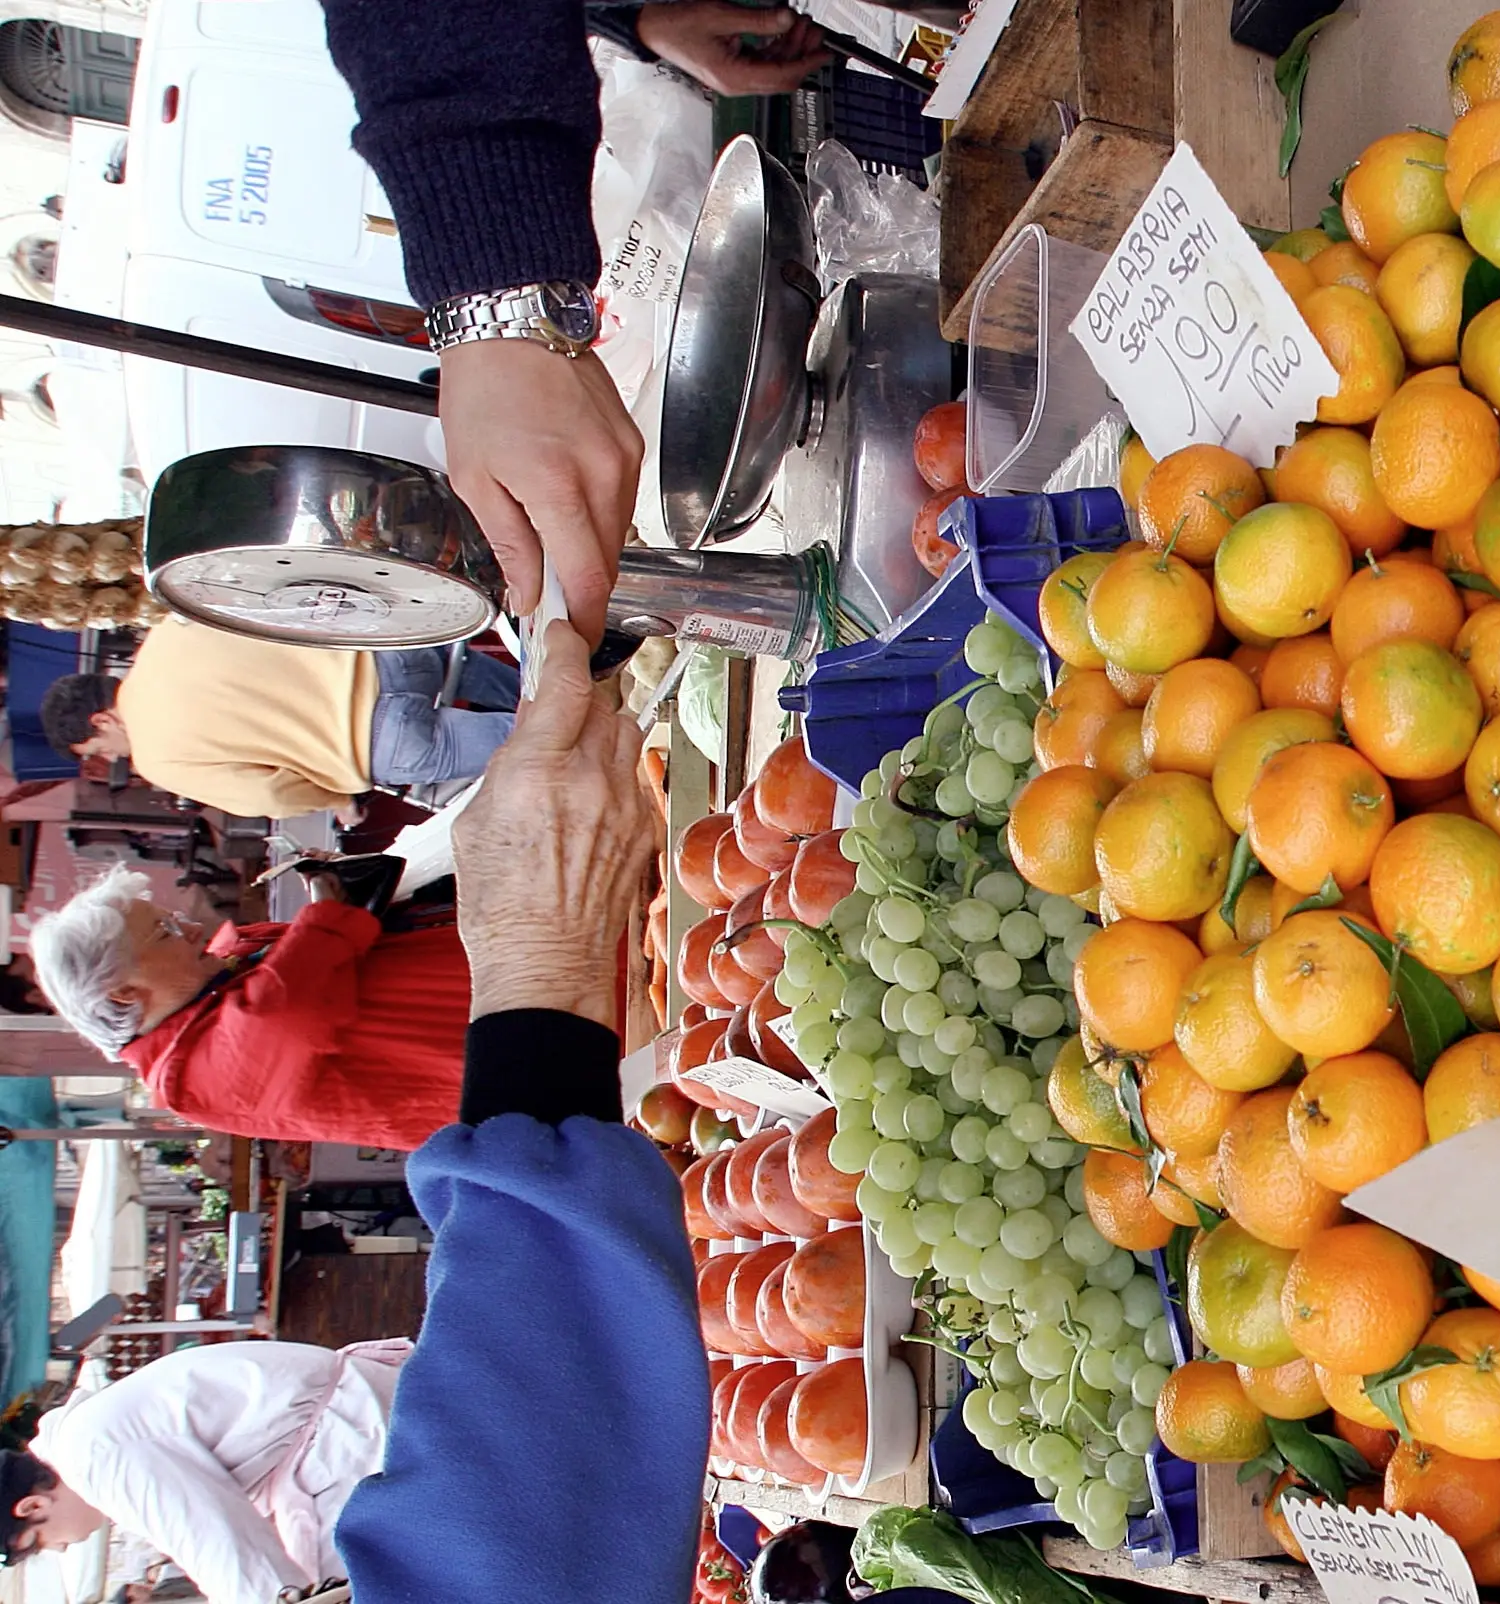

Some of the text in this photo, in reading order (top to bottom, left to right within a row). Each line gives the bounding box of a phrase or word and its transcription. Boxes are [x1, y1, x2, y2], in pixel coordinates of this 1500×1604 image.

[241, 143, 273, 204] 2005
[1087, 186, 1190, 344] CALABRIA
[1120, 218, 1218, 363] SENZA SEMI
[1247, 335, 1301, 409] KILO
[1311, 1548, 1366, 1576] SENZA
